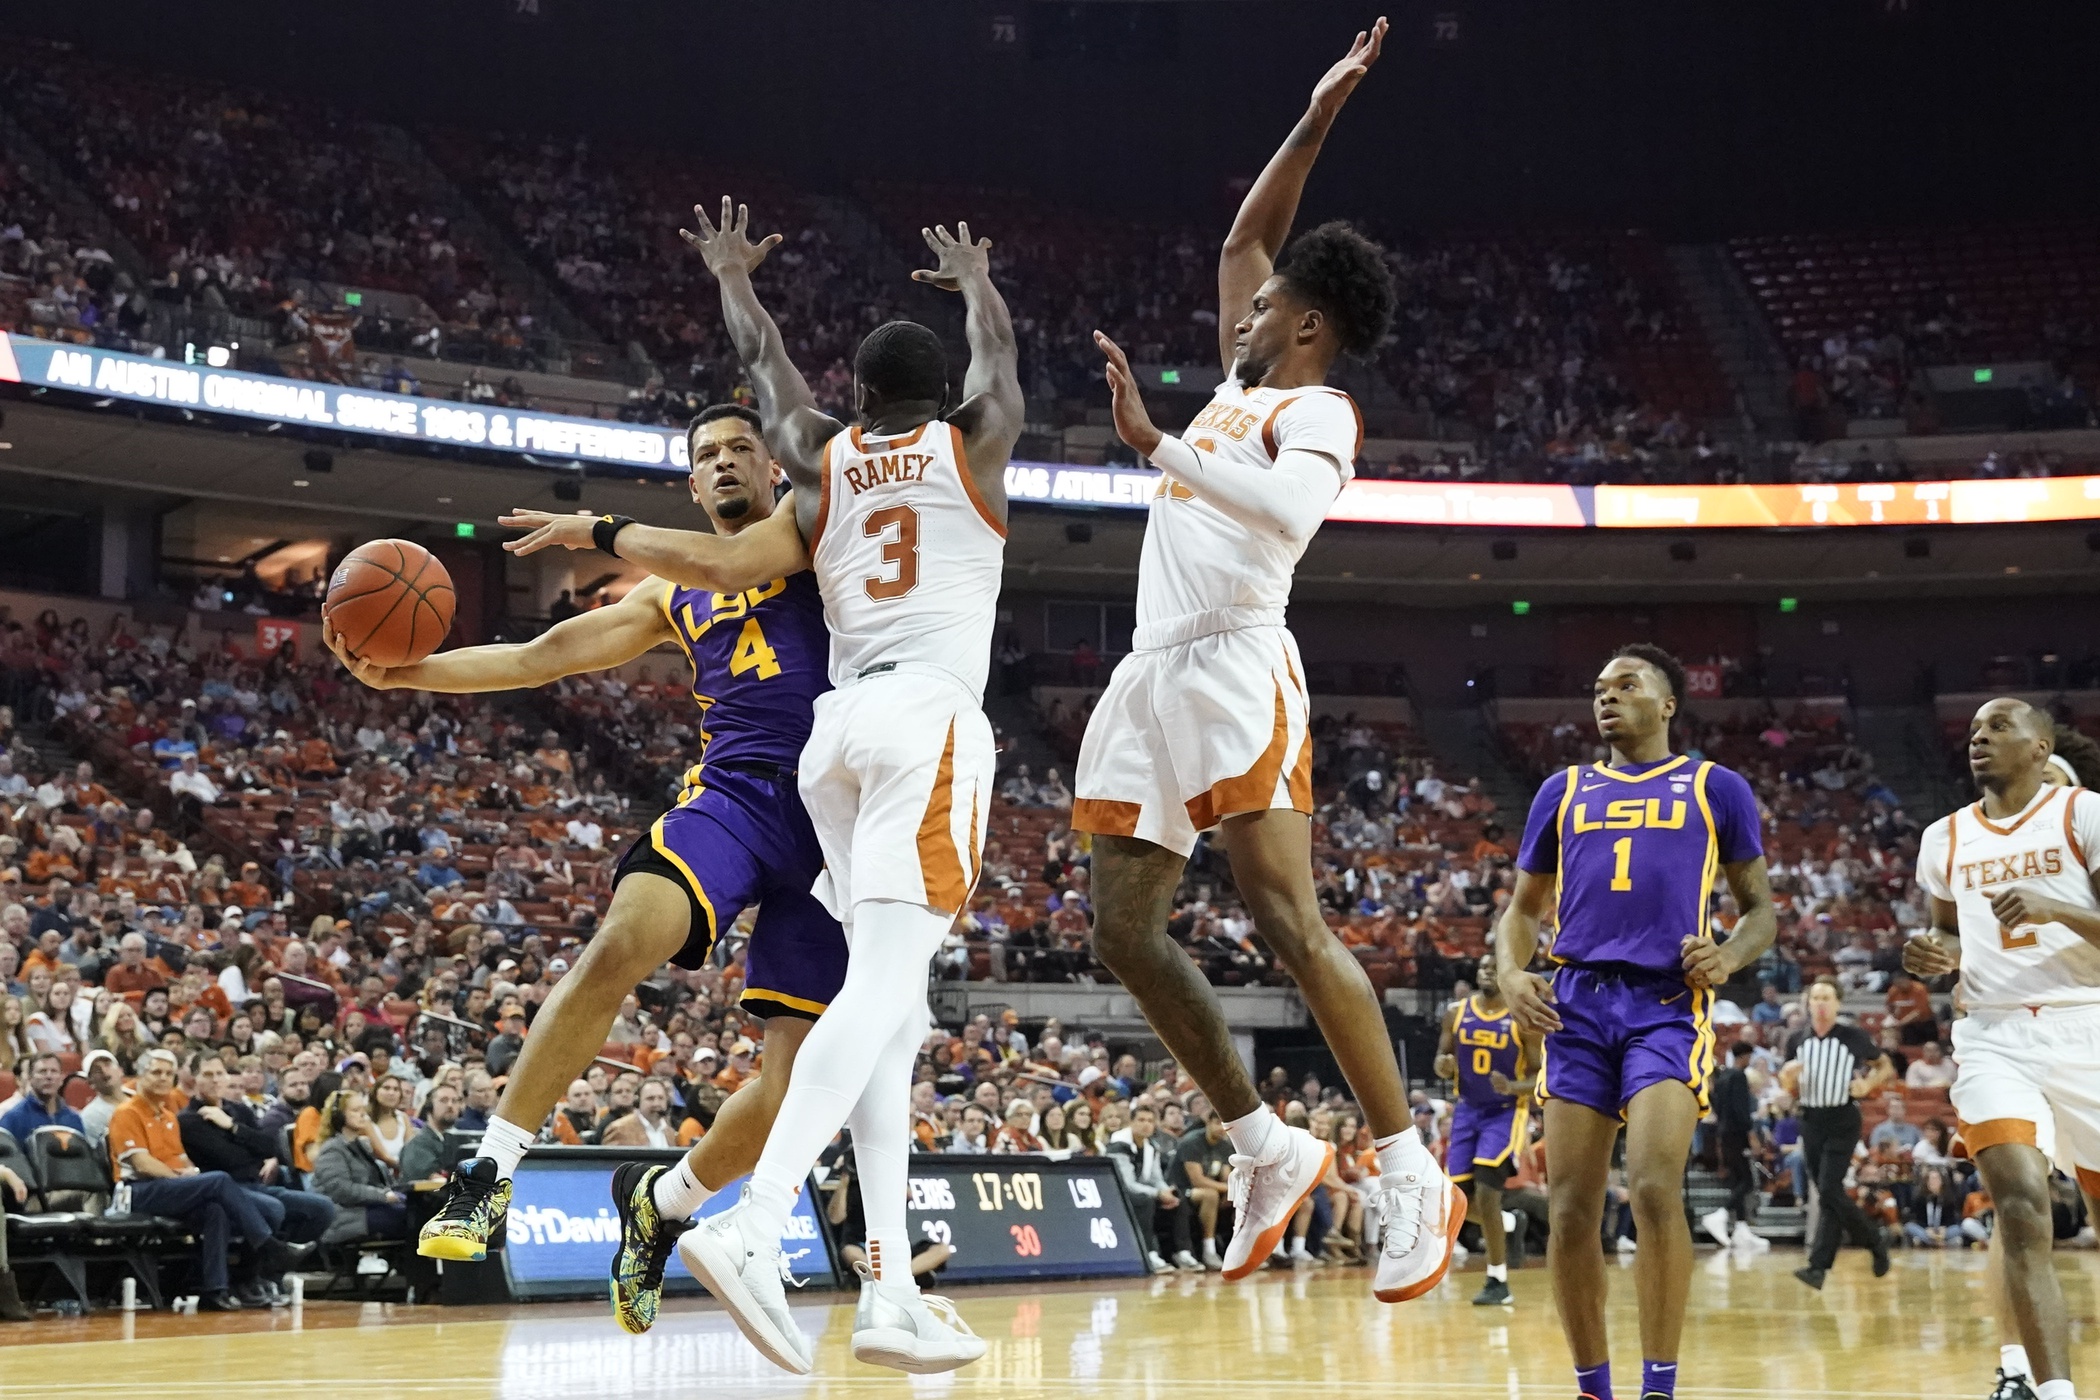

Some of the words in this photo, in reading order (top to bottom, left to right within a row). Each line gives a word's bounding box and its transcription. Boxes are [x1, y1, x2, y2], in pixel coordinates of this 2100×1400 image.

[1435, 21, 1458, 40] 72
[47, 350, 92, 387] AN
[95, 358, 199, 403] AUSTIN
[336, 394, 417, 434] SINCE
[489, 415, 512, 446] &
[516, 417, 665, 466] PREFERRED
[1190, 402, 1262, 441] EXAS
[844, 454, 934, 495] RAMEY
[1052, 469, 1163, 505] ATHLETI
[862, 502, 920, 603] 3
[729, 616, 782, 681] 4
[1573, 798, 1687, 834] LSU
[1611, 837, 1632, 891] 1
[1959, 846, 2063, 890] TEXAS
[1459, 1027, 1509, 1049] LSU
[1473, 1048, 1491, 1075] 0
[908, 1178, 956, 1210] EXAS
[972, 1173, 1043, 1210] 17:07
[1068, 1178, 1102, 1208] LSU
[1010, 1224, 1042, 1257] 30
[1090, 1217, 1118, 1249] 46
